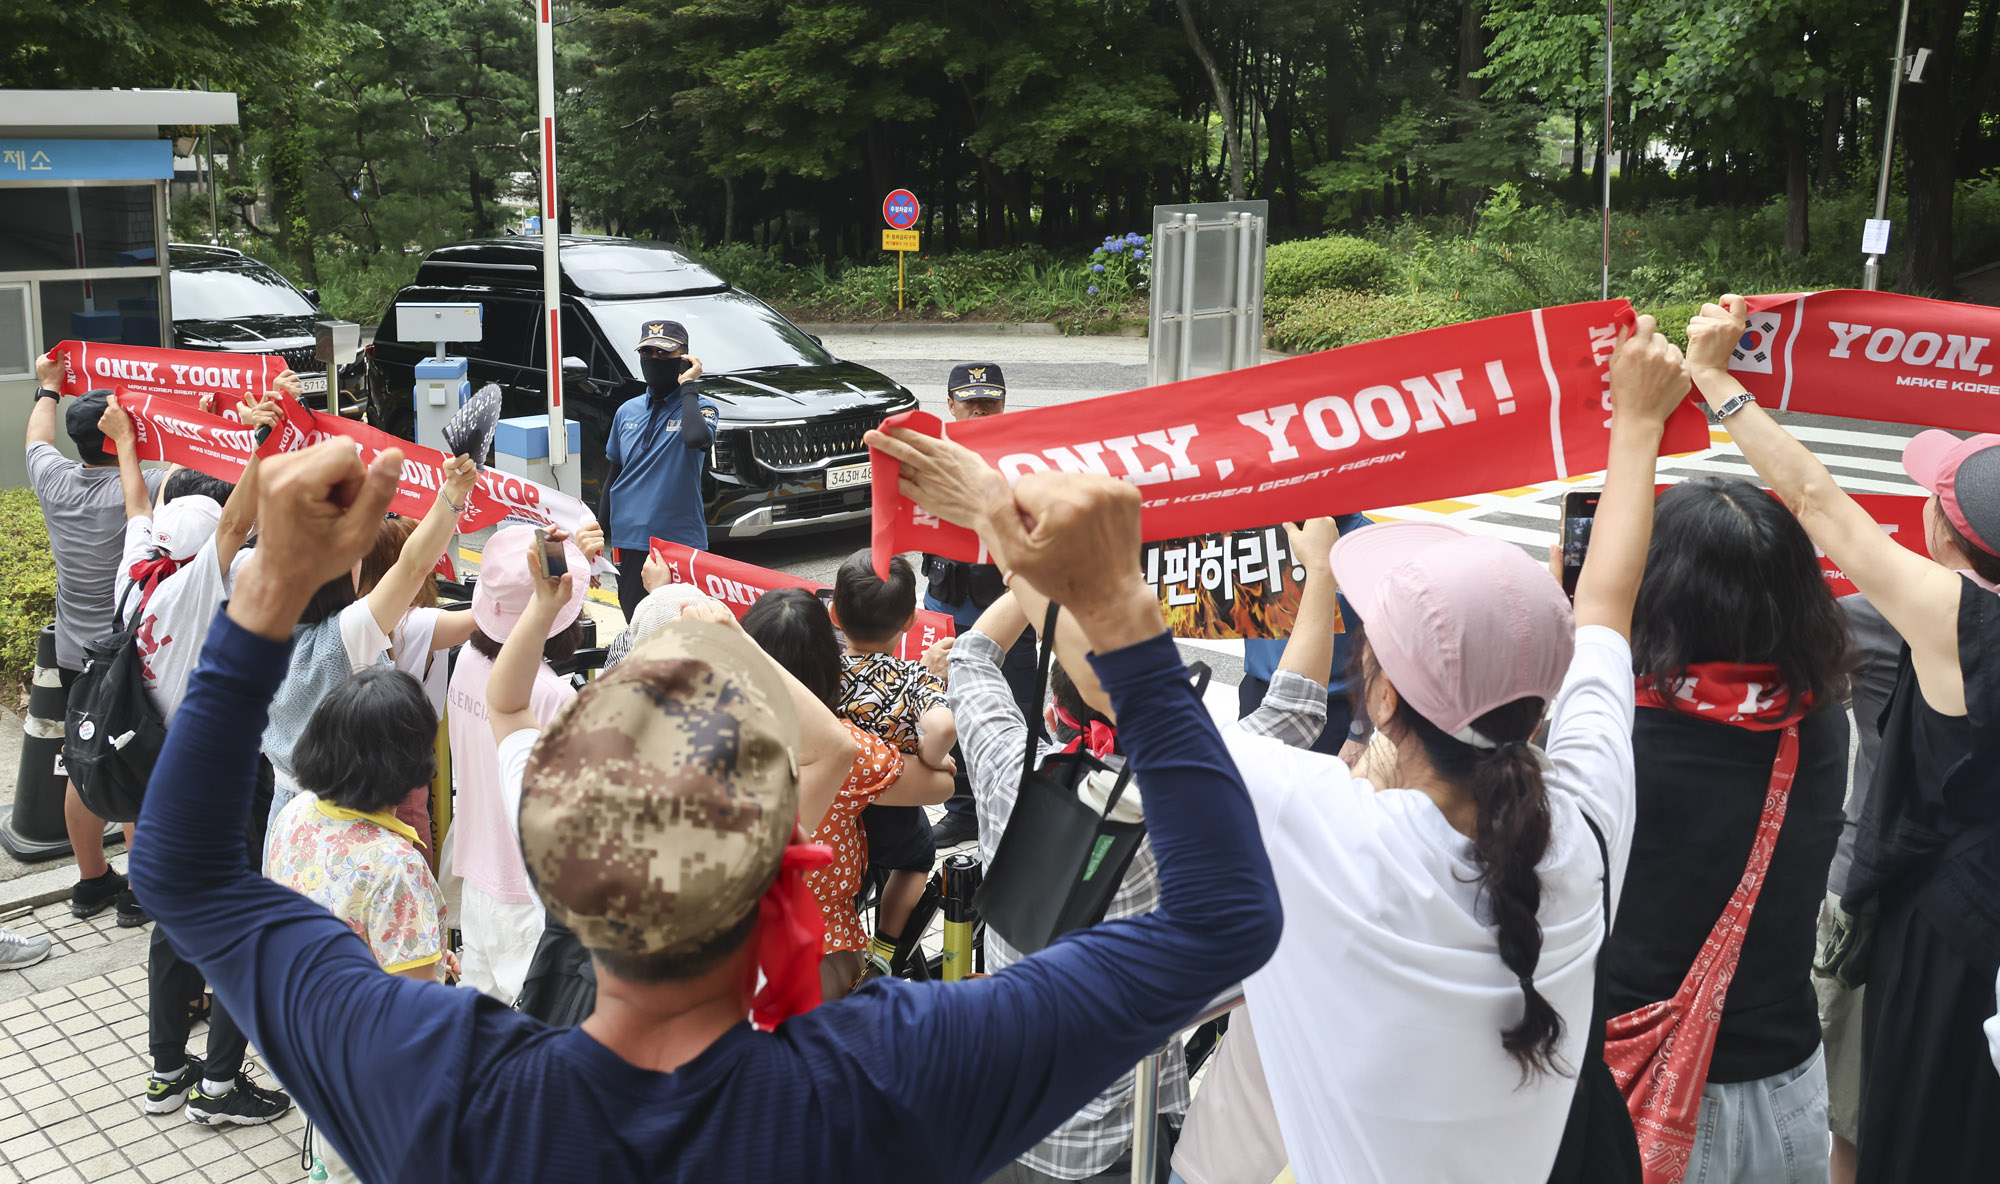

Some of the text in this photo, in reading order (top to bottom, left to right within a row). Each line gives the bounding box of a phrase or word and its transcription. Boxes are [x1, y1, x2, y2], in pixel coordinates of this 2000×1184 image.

[3, 150, 52, 171] 제소
[1828, 321, 1994, 377] YOON,
[148, 386, 173, 394] KOREA
[303, 380, 326, 391] 5712
[1896, 376, 2000, 395] MAKE KORE
[861, 467, 872, 480] 48
[1141, 451, 1408, 508] KE KOREA GREAT AGAIN
